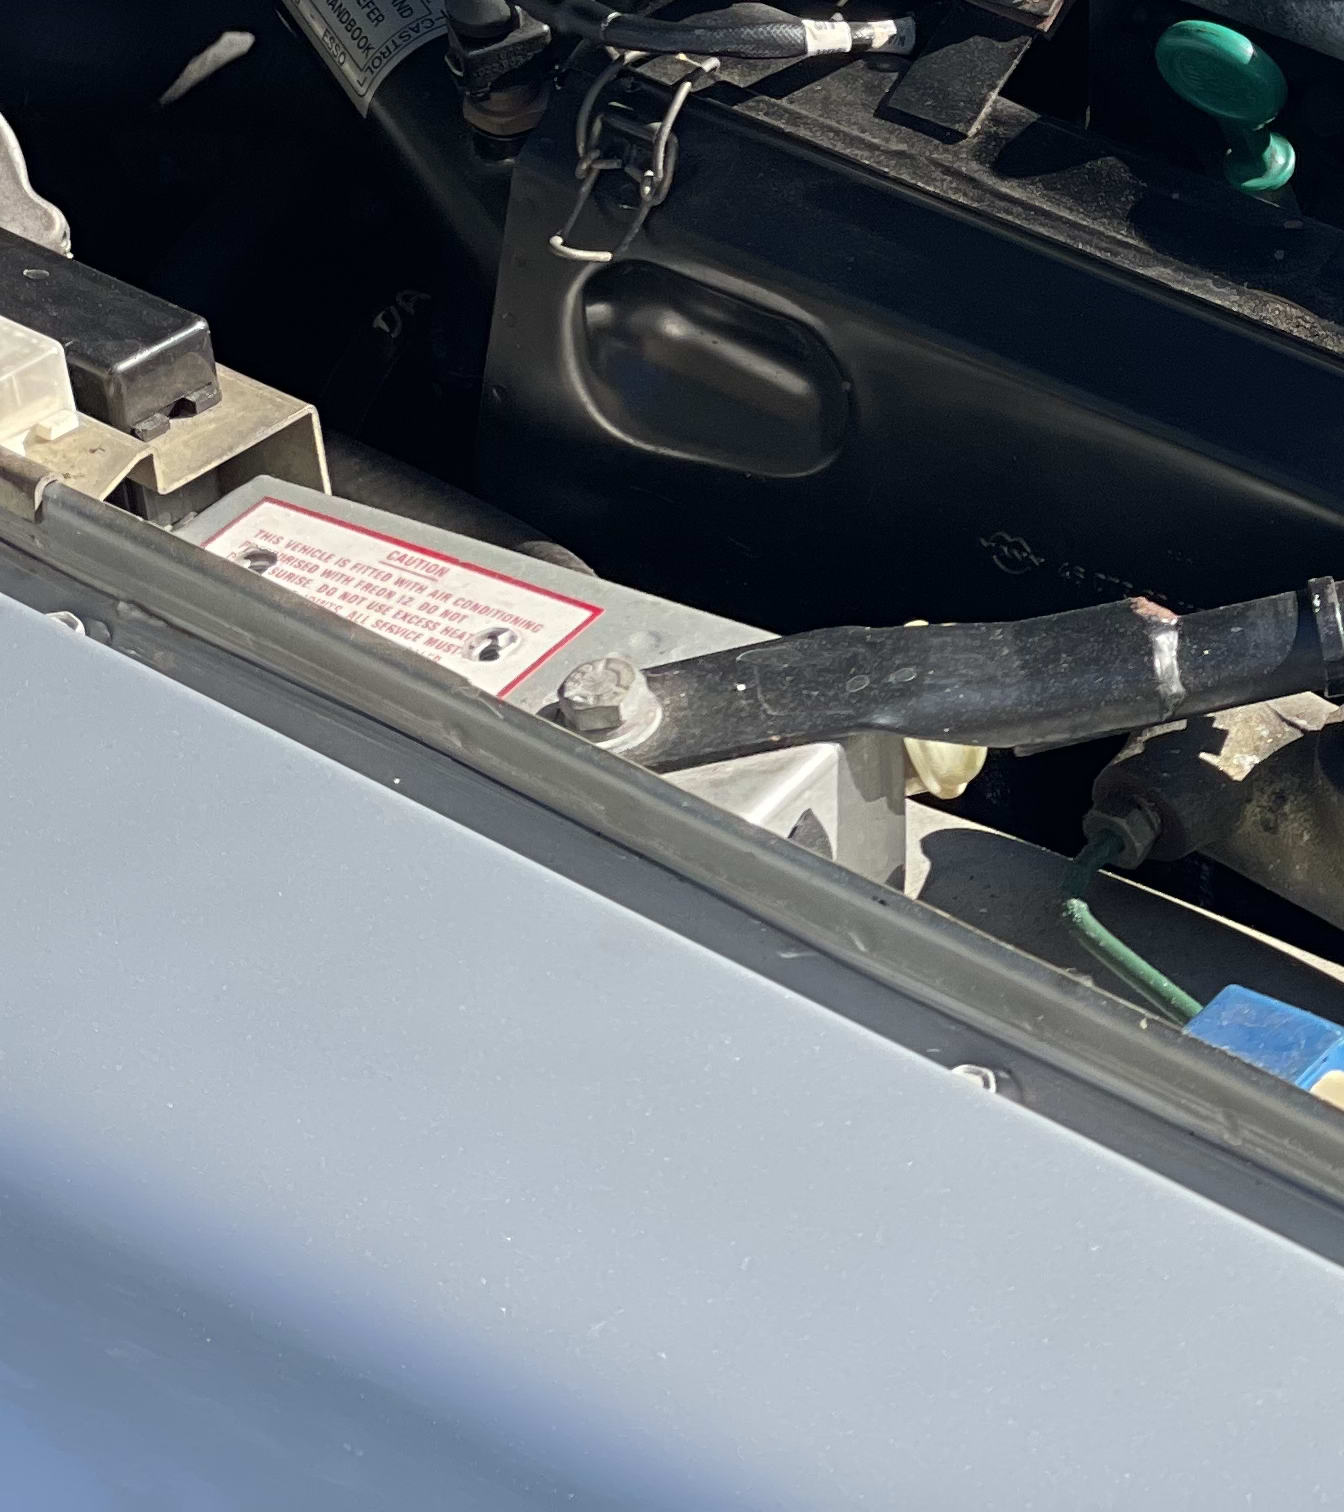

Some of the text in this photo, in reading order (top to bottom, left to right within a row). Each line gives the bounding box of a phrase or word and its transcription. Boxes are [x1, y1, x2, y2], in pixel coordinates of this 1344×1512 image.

[321, 27, 347, 65] ESSO
[364, 18, 434, 75] CASTROL
[251, 528, 545, 633] THIS VEHICLE IS FITTED WITH AIR CONDITIONING
[383, 550, 452, 578] CAUTION
[314, 583, 341, 597] DO
[336, 590, 367, 606] NOT
[364, 600, 395, 616] USE
[389, 609, 442, 631] EXCESS
[317, 568, 354, 586] WITH
[351, 580, 397, 600] FREON
[416, 602, 441, 614] DO
[437, 608, 469, 623] NOT
[367, 619, 424, 643] SERVICE
[419, 637, 464, 656] MUST
